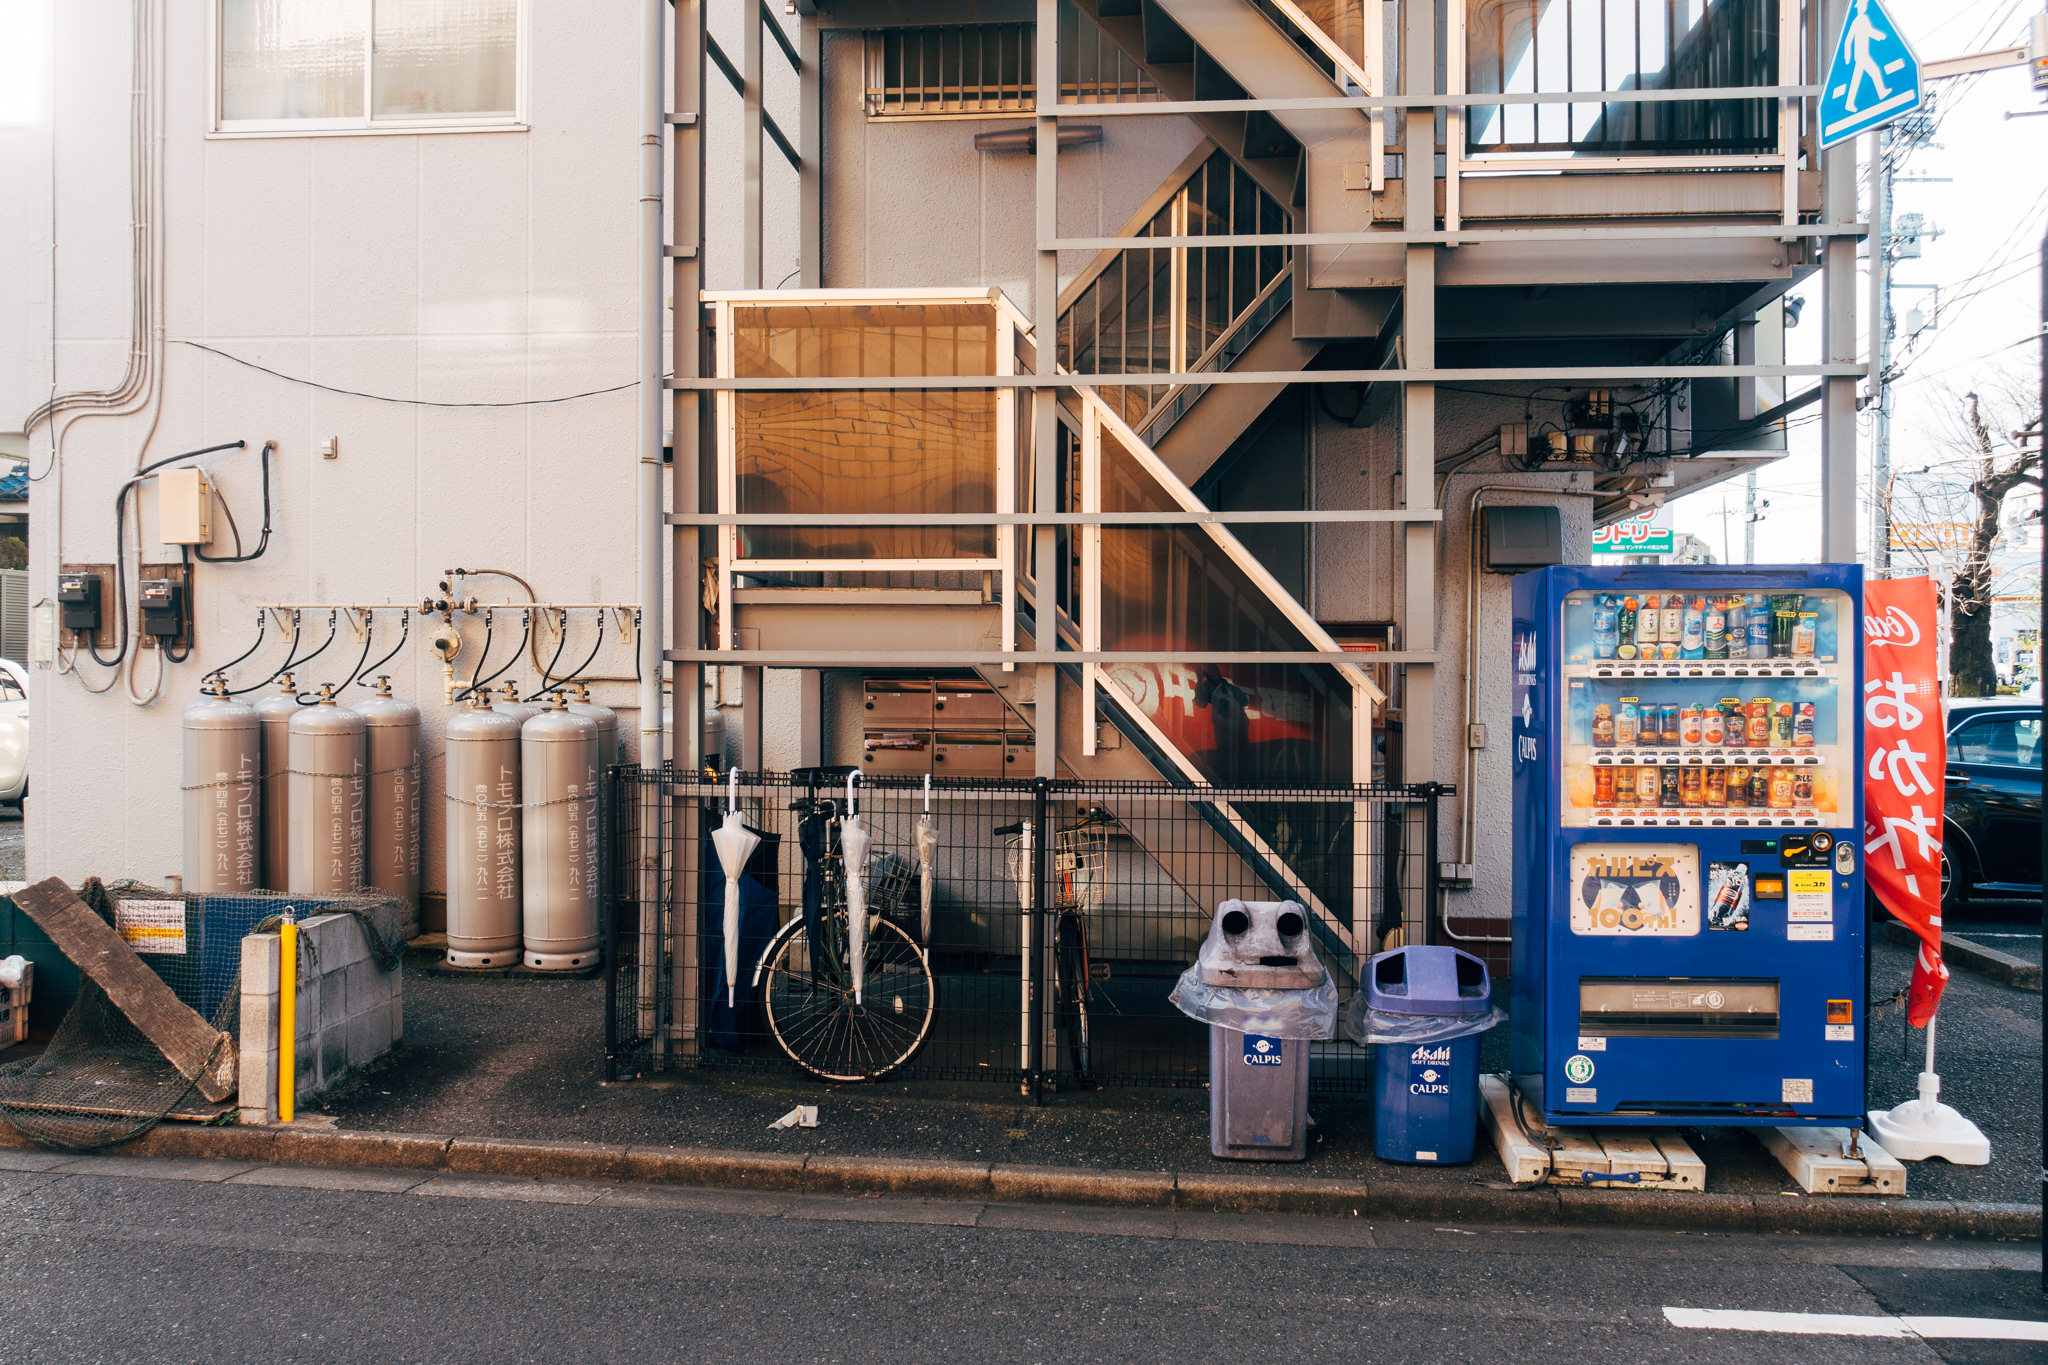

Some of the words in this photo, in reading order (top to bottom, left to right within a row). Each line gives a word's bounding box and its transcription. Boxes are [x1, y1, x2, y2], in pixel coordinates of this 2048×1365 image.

[1518, 631, 1537, 671] Asahi
[1518, 734, 1537, 763] CALPIS
[496, 765, 515, 900] トモプロ株式会社
[1587, 856, 1677, 878] カルピス
[1243, 1054, 1282, 1066] CALPIS
[1411, 1045, 1451, 1061] Asahi
[1410, 1083, 1449, 1096] CALPIS
